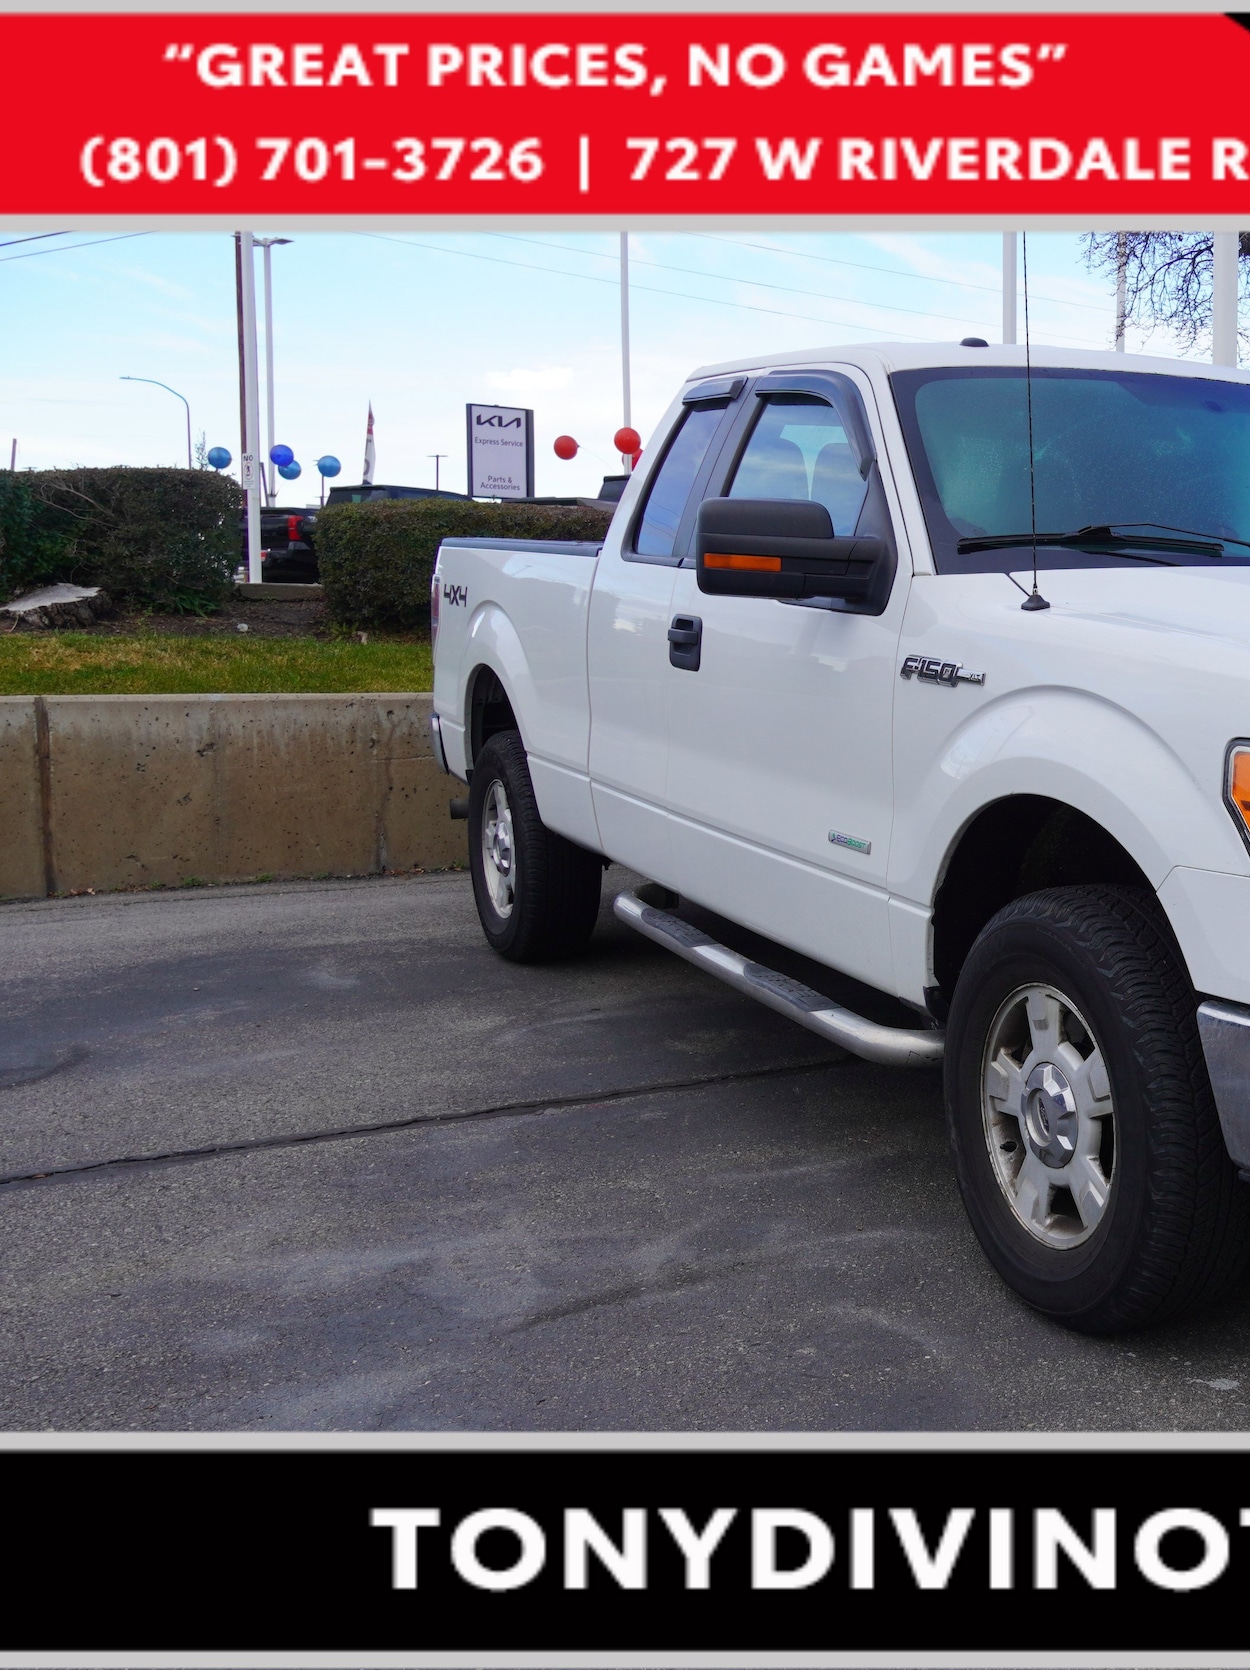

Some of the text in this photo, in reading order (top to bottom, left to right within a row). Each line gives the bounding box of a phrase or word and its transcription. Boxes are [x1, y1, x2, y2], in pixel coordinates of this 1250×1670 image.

[476, 414, 521, 428] KIA
[475, 437, 523, 447] Express Service
[243, 454, 254, 462] NO
[487, 475, 506, 483] Parts
[480, 482, 520, 491] Accessories
